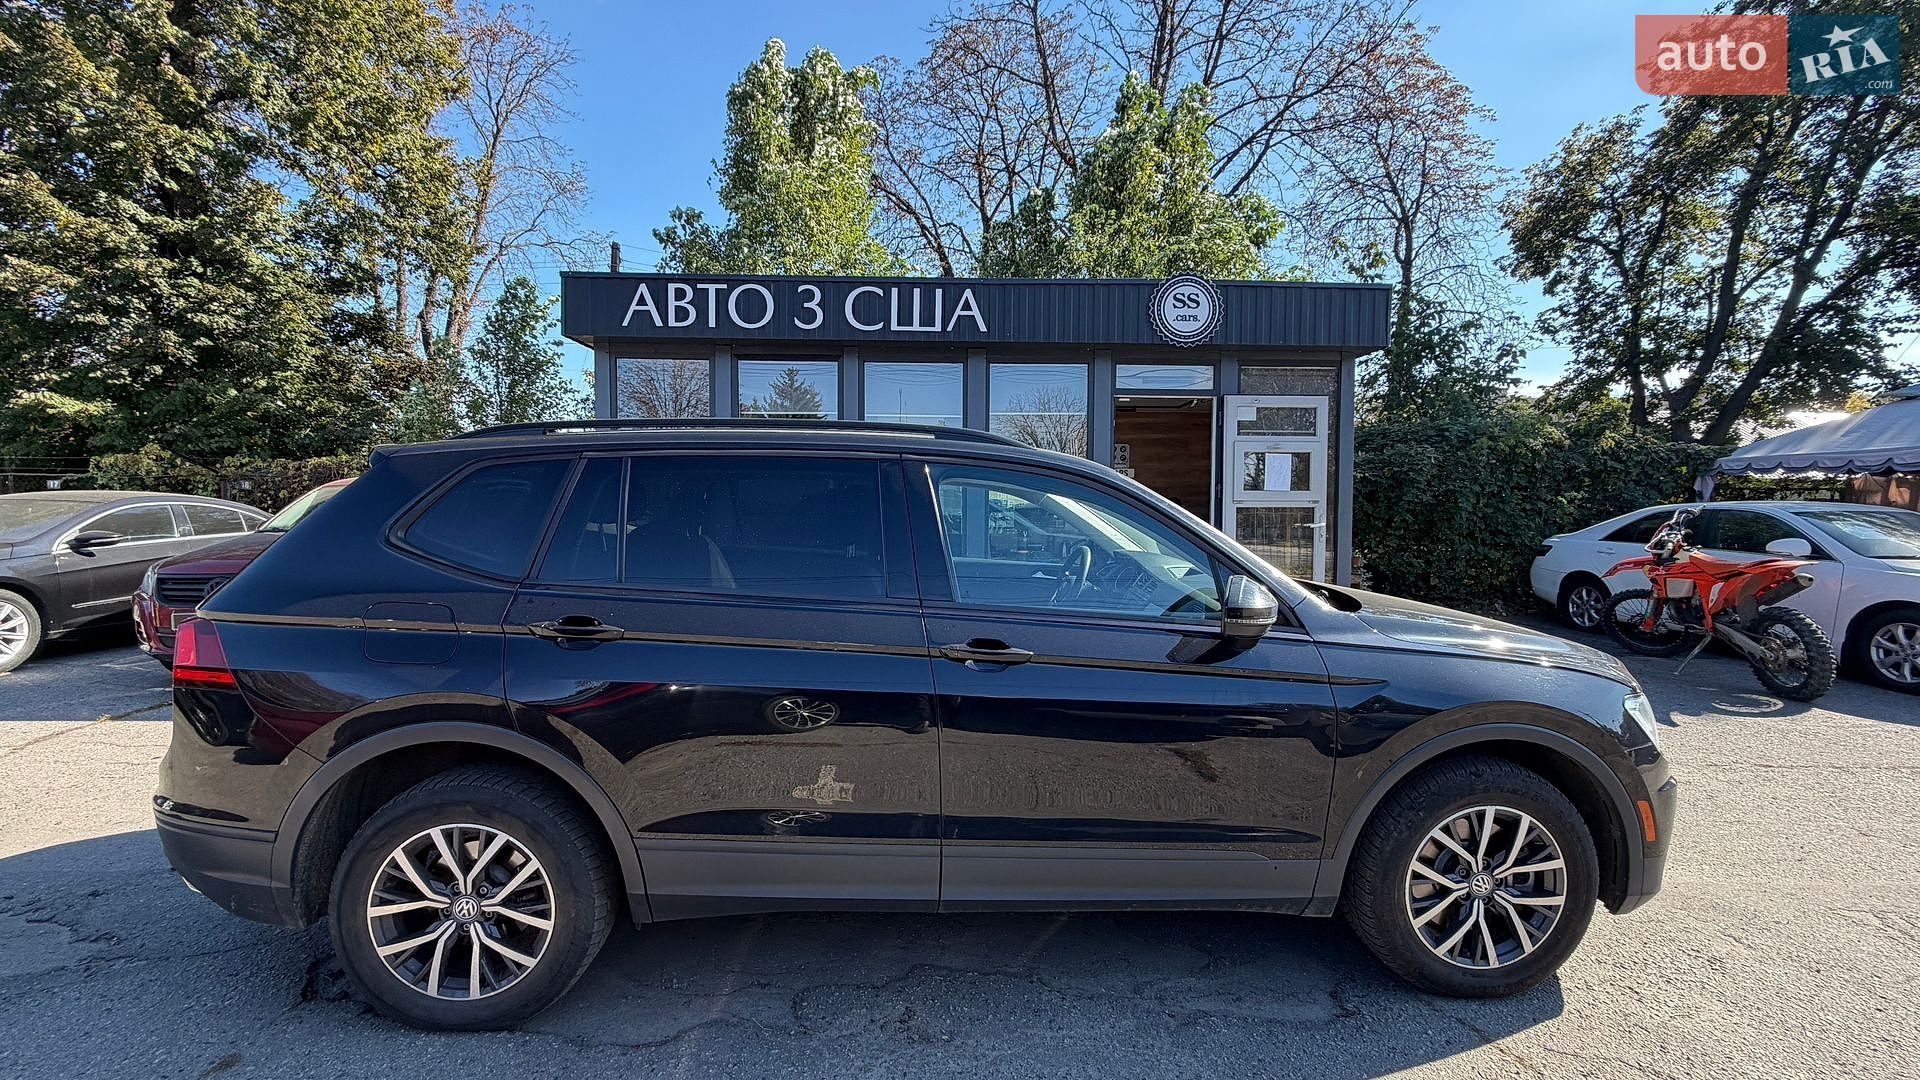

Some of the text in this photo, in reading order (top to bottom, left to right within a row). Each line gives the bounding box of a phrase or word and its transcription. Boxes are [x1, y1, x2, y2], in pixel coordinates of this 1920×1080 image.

[621, 283, 988, 332] АВТО З США
[1172, 292, 1201, 310] SS
